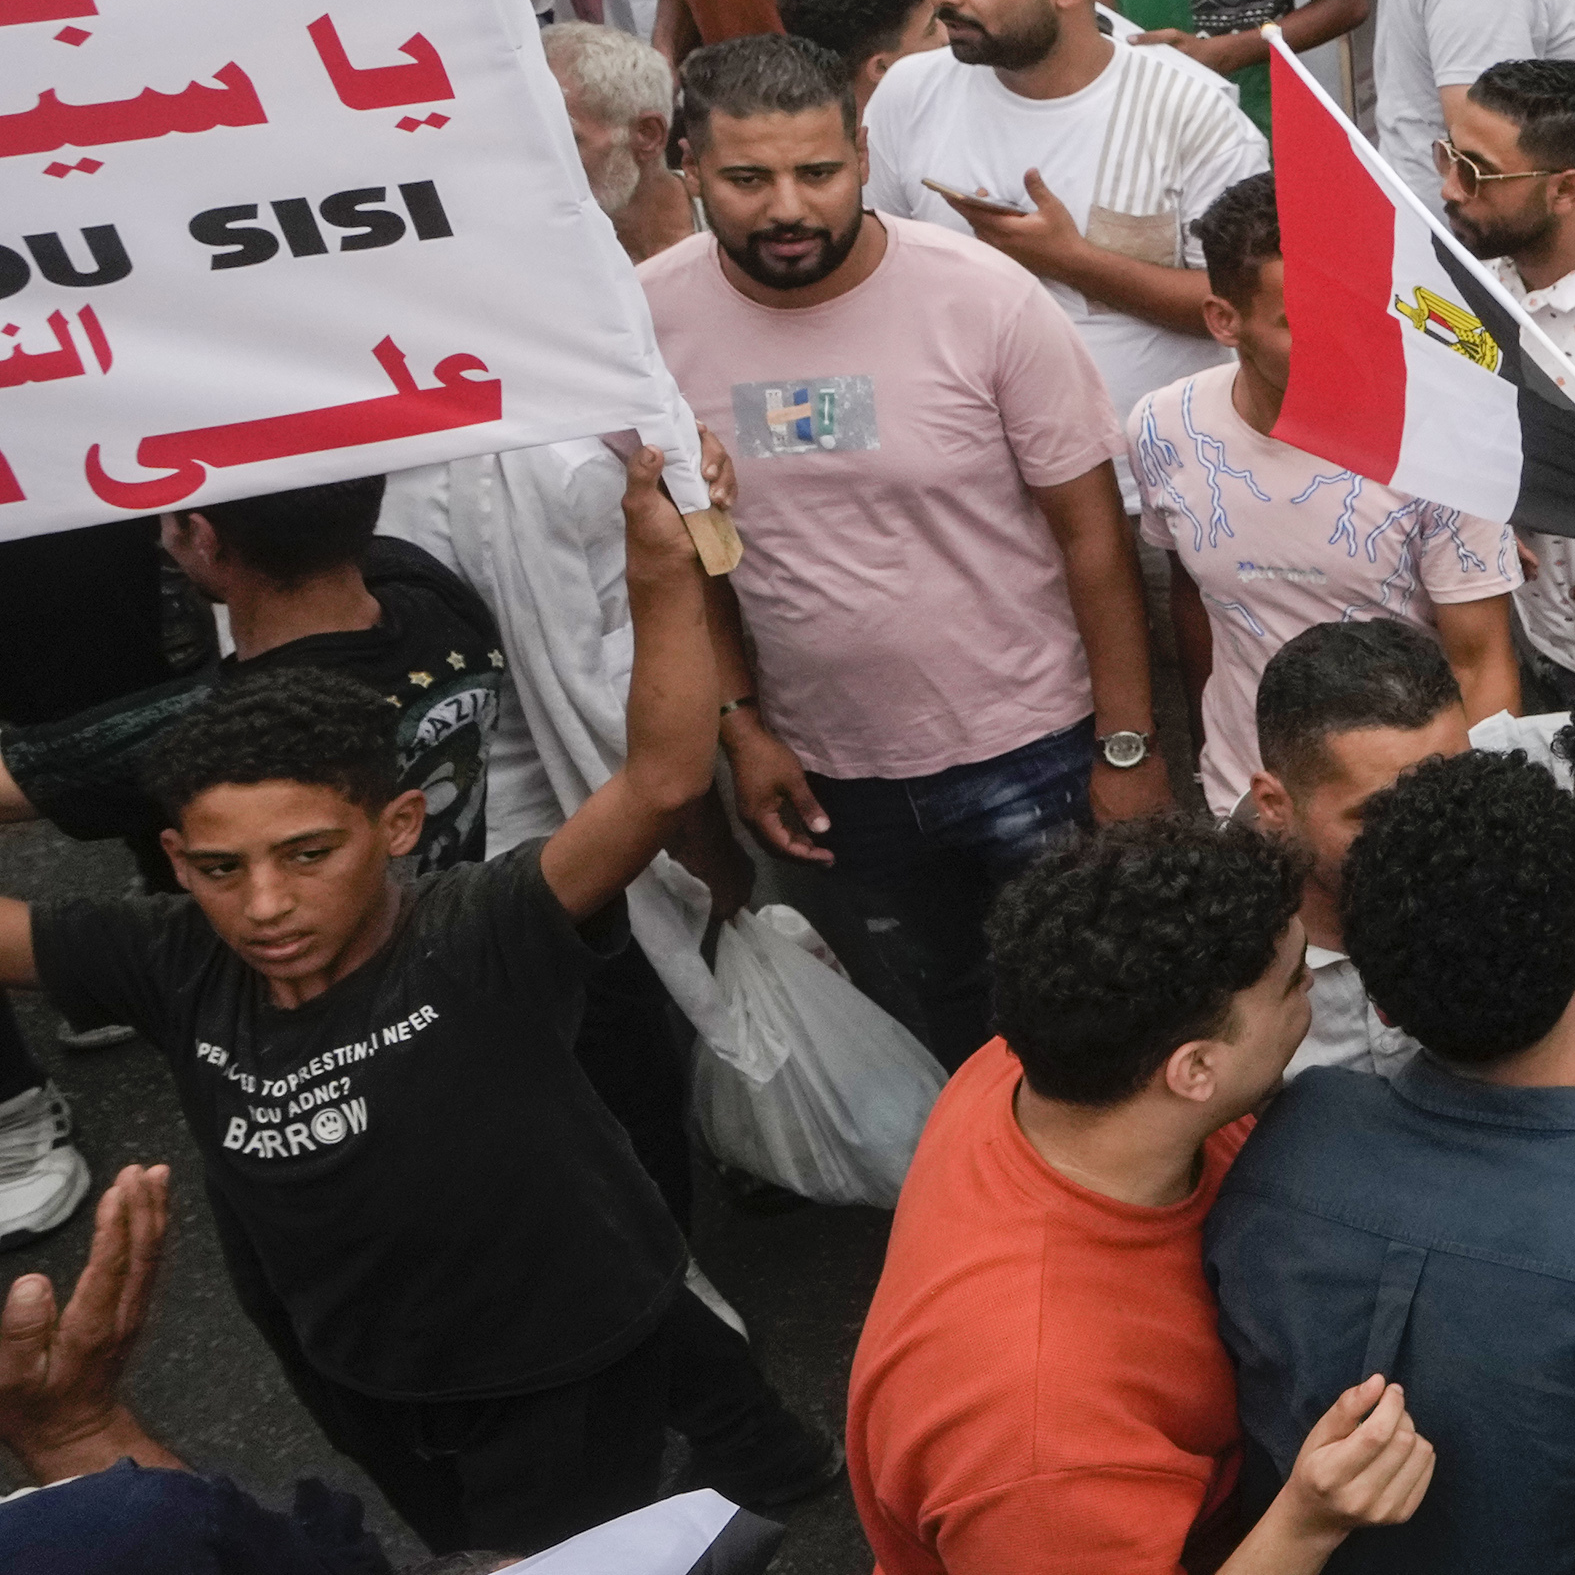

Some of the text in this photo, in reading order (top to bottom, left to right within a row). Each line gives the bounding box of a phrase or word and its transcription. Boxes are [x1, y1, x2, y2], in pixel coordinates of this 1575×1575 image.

[306, 12, 456, 134] يا
[187, 179, 455, 272] SISI
[85, 334, 503, 510] على
